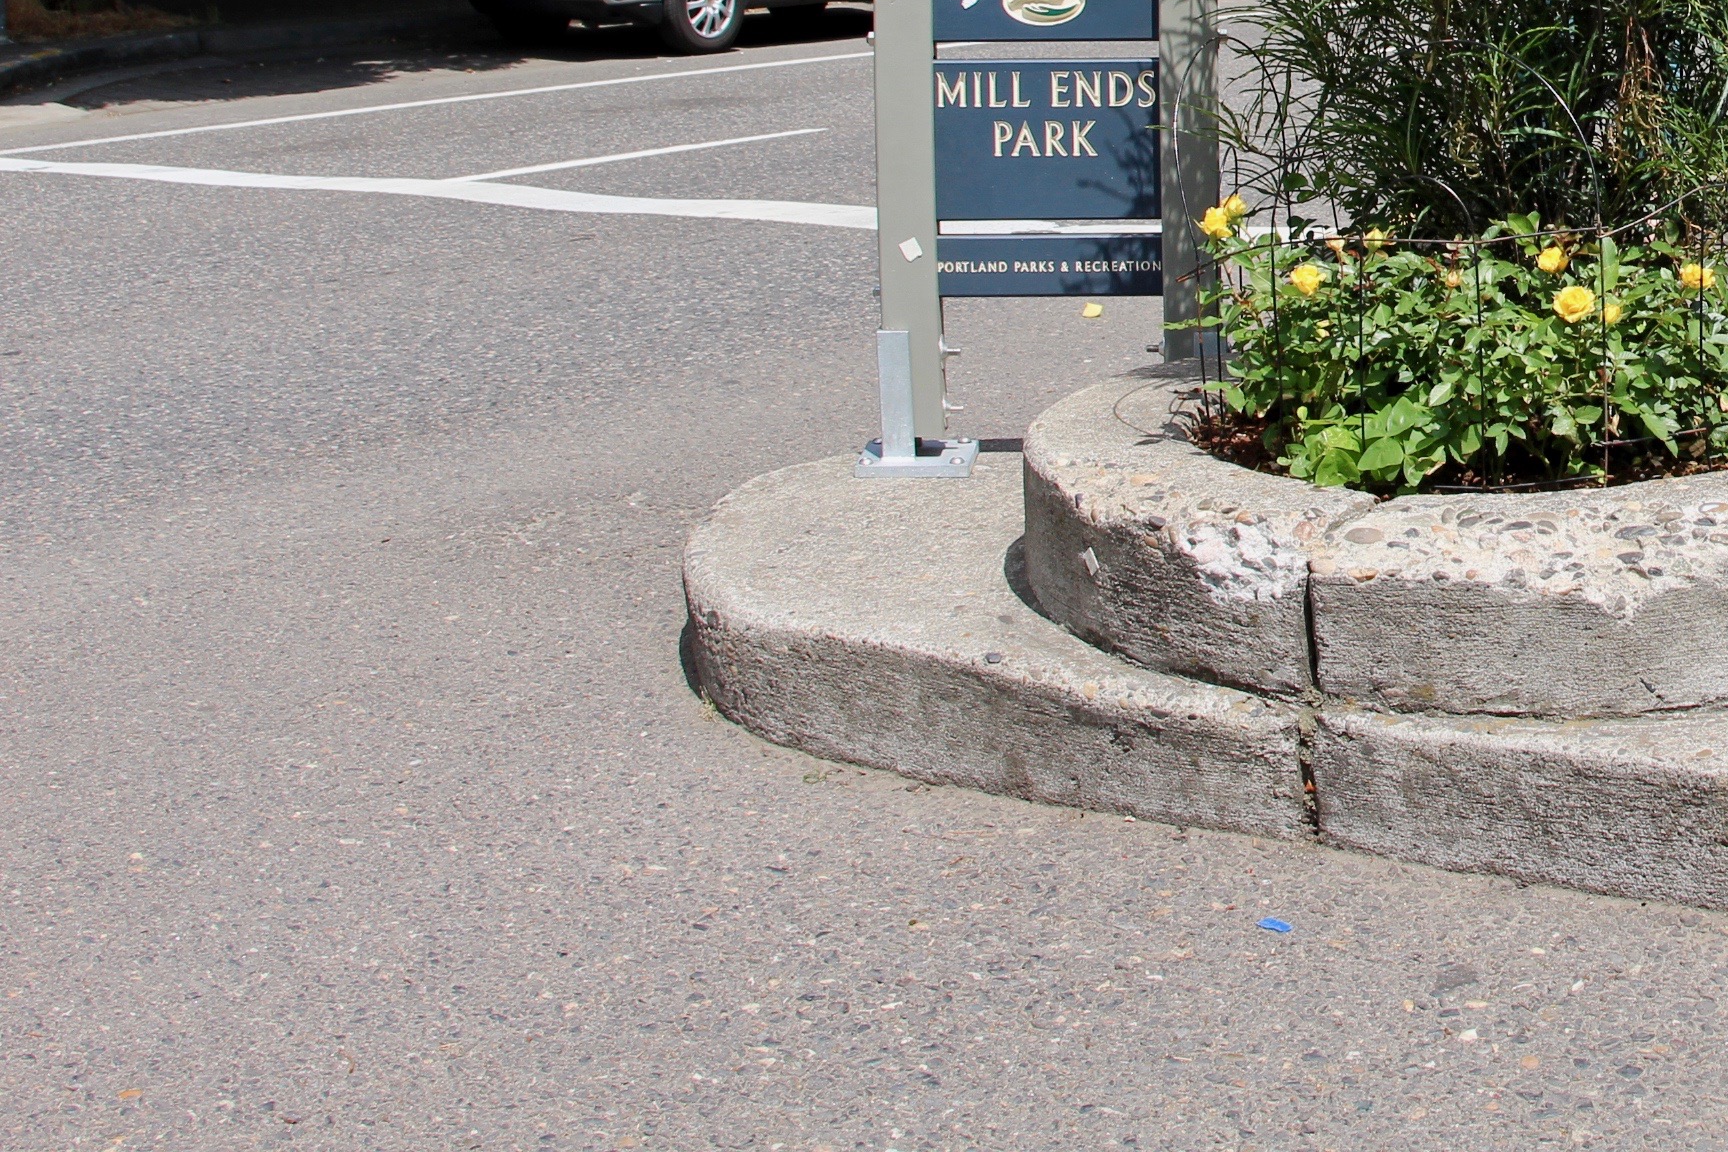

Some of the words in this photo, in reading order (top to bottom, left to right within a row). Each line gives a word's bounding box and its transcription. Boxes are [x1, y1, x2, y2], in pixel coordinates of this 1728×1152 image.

[935, 71, 1031, 108] MILL
[1050, 70, 1157, 108] ENDS
[993, 119, 1099, 157] PARK
[937, 260, 1008, 274] PORTLAND
[1013, 260, 1055, 273] PARKS
[1060, 260, 1069, 273] &
[1074, 260, 1163, 273] RECREATION
